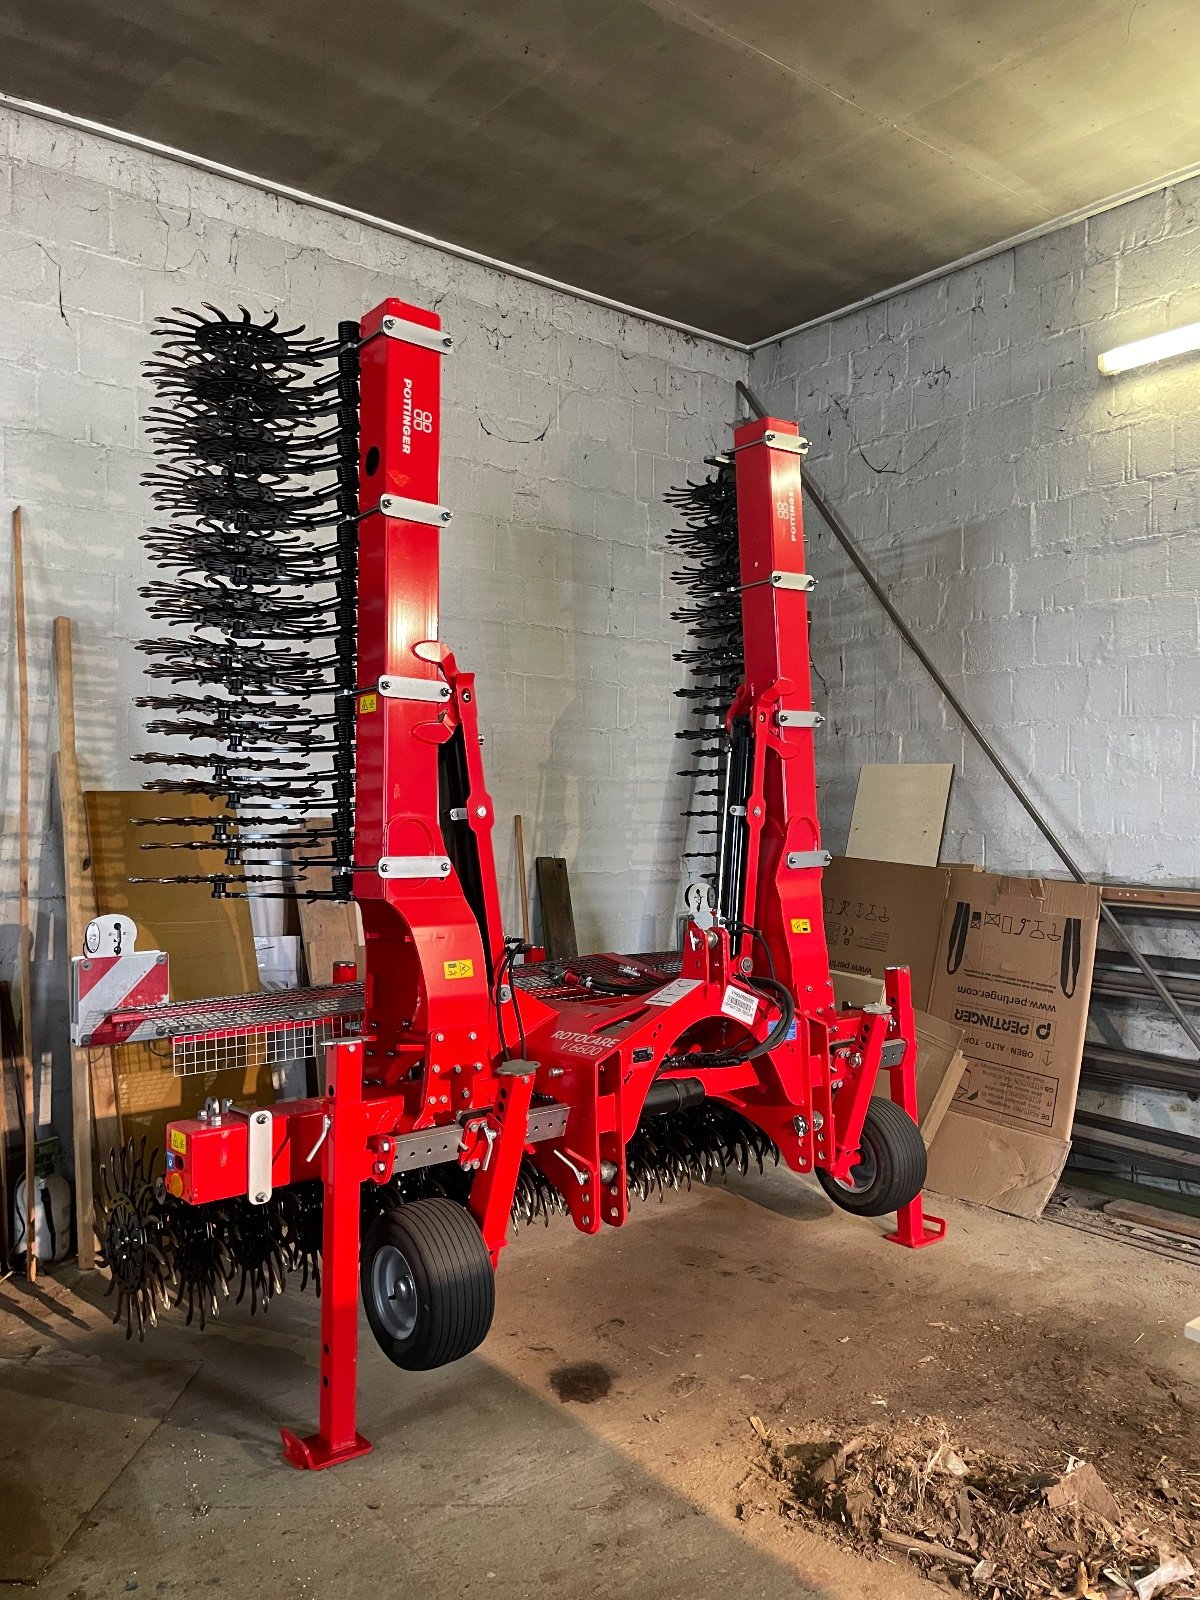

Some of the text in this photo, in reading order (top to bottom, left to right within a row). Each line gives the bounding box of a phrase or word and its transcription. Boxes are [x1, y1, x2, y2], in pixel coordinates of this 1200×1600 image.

[957, 985, 1057, 1013] www.pertinger.com
[954, 1008, 1030, 1036] PERTINGER
[550, 1030, 621, 1048] ROTOCARE
[560, 1042, 603, 1056] V 6600
[963, 1036, 1034, 1059] OBEN ALTO TOP
[1041, 1113, 1050, 1121] DE
